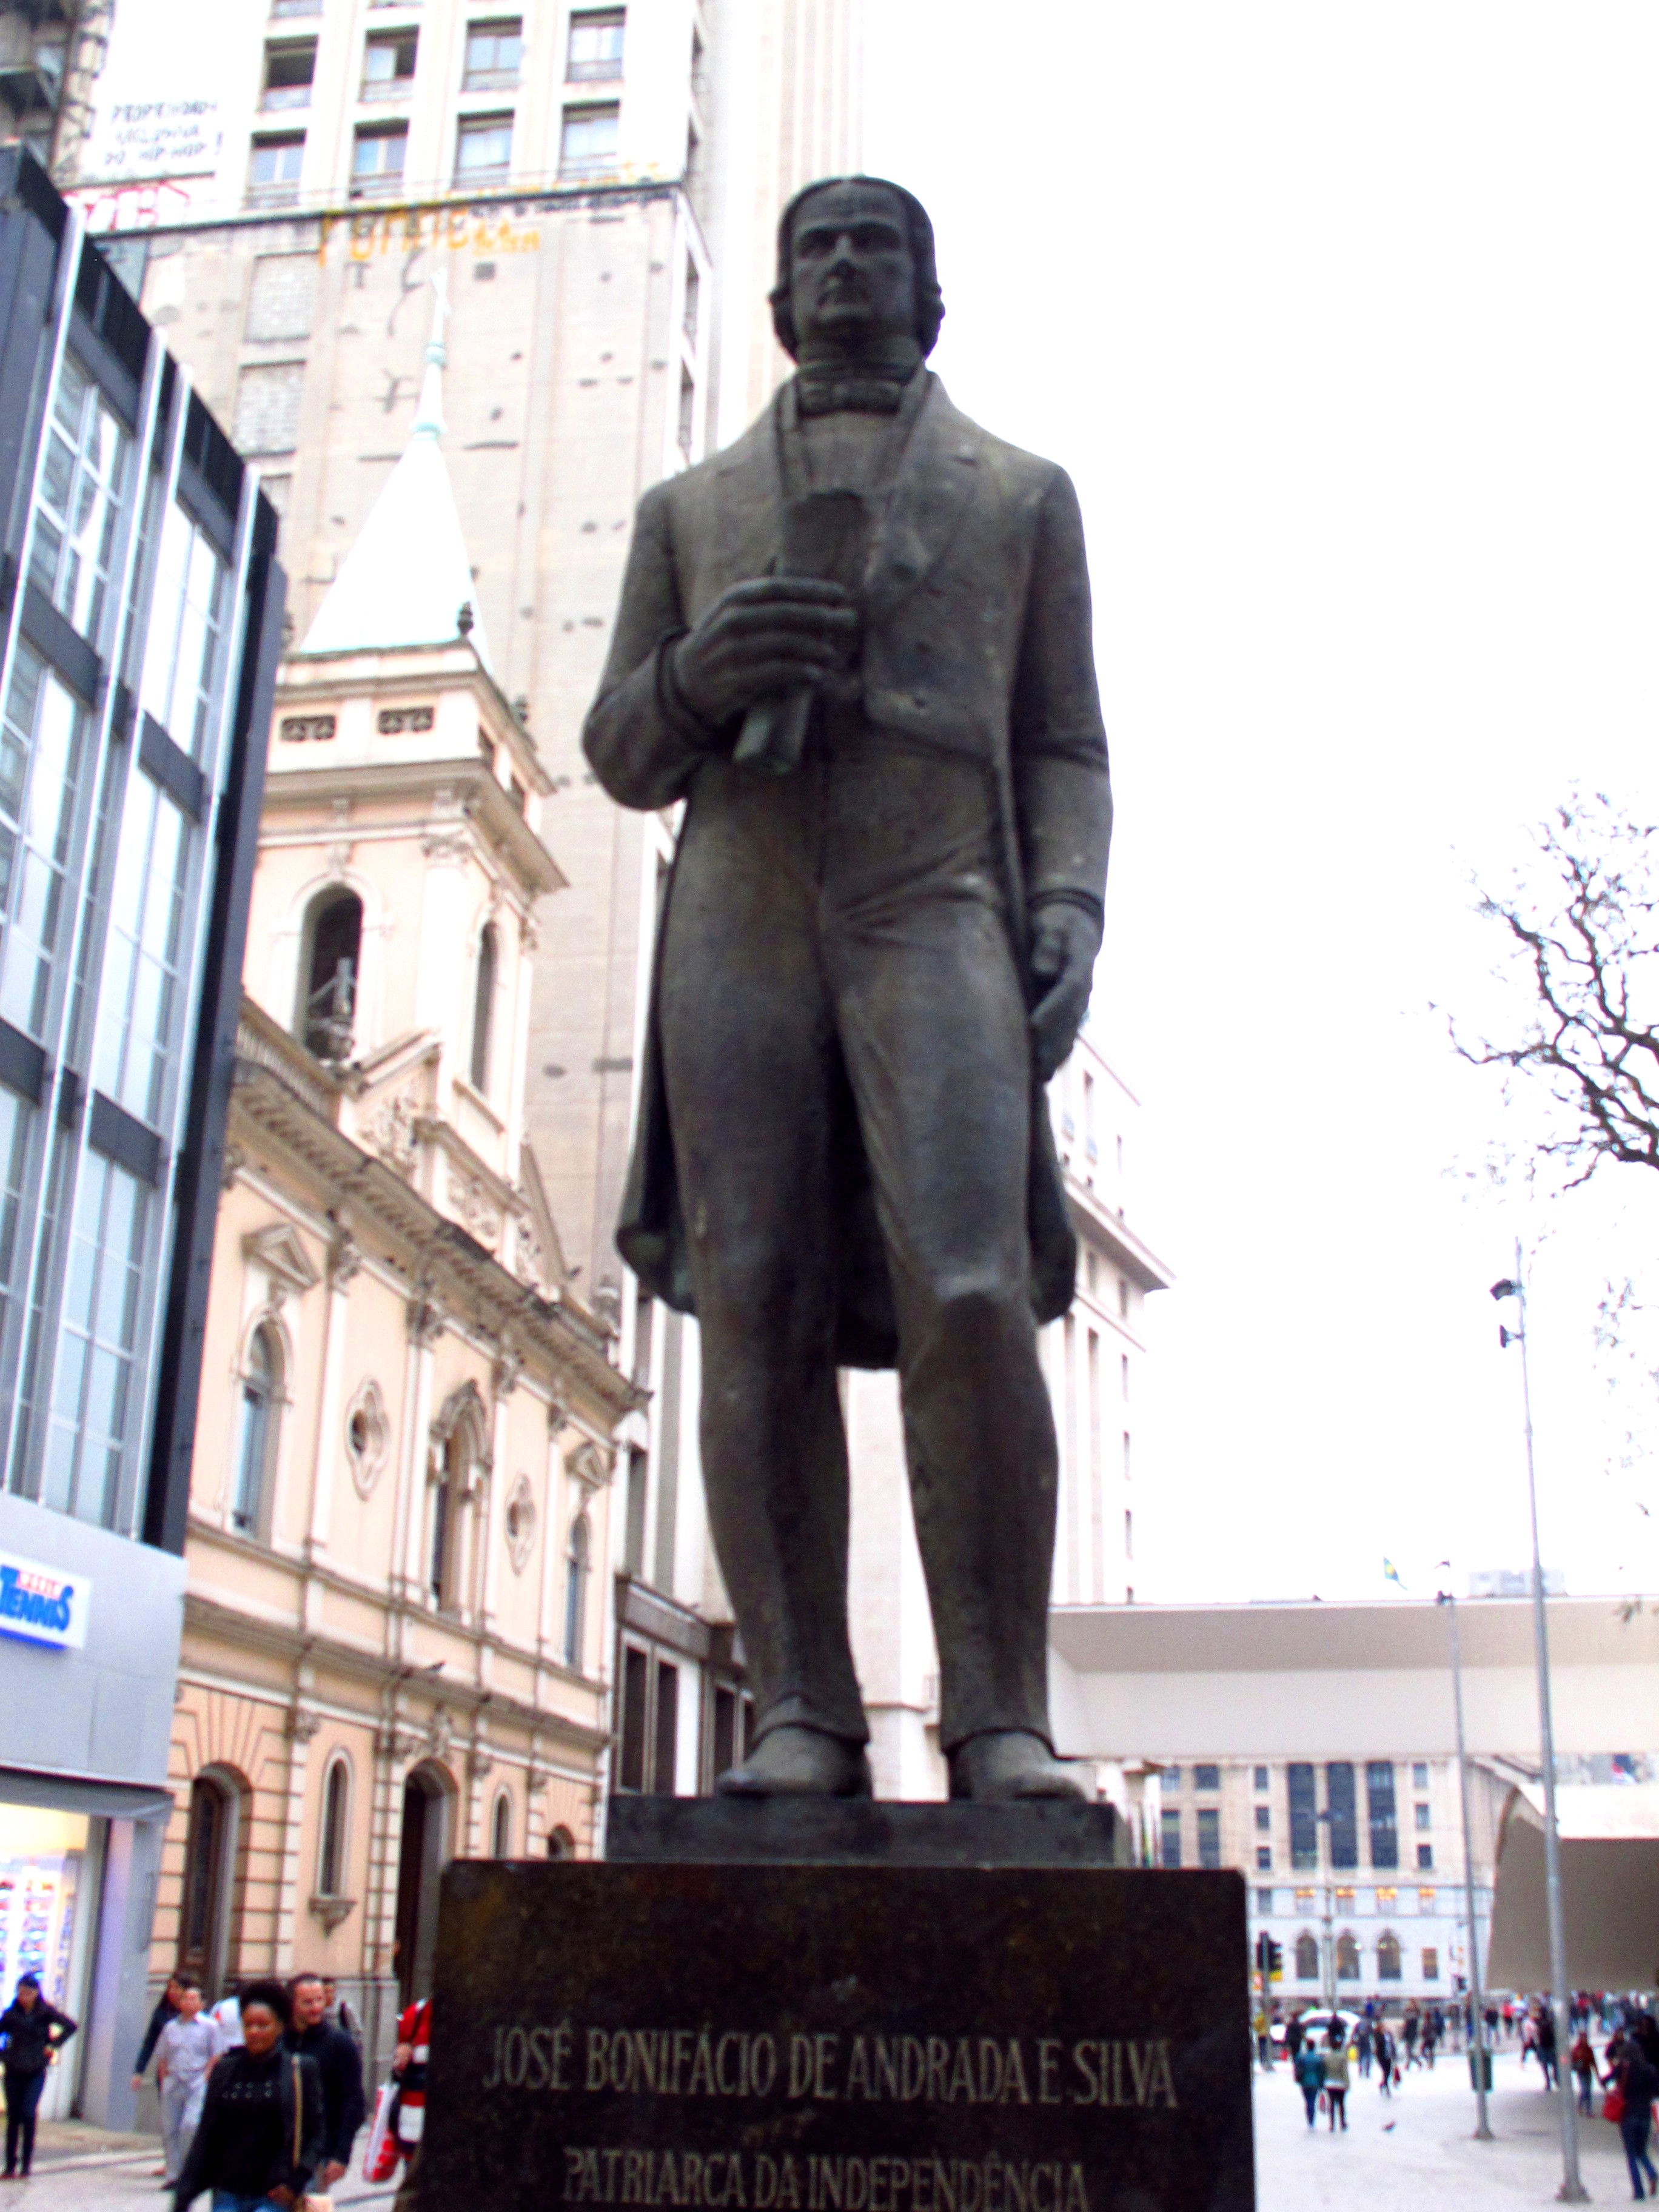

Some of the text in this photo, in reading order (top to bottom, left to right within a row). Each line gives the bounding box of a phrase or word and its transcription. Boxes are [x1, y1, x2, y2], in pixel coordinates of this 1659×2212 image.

[483, 2018, 1178, 2108] JOSÉ BONIFÁCIO DE ANDRADA E SILVA
[563, 2147, 1091, 2212] PATRIARCA DA INDEPENDÊNCIA
